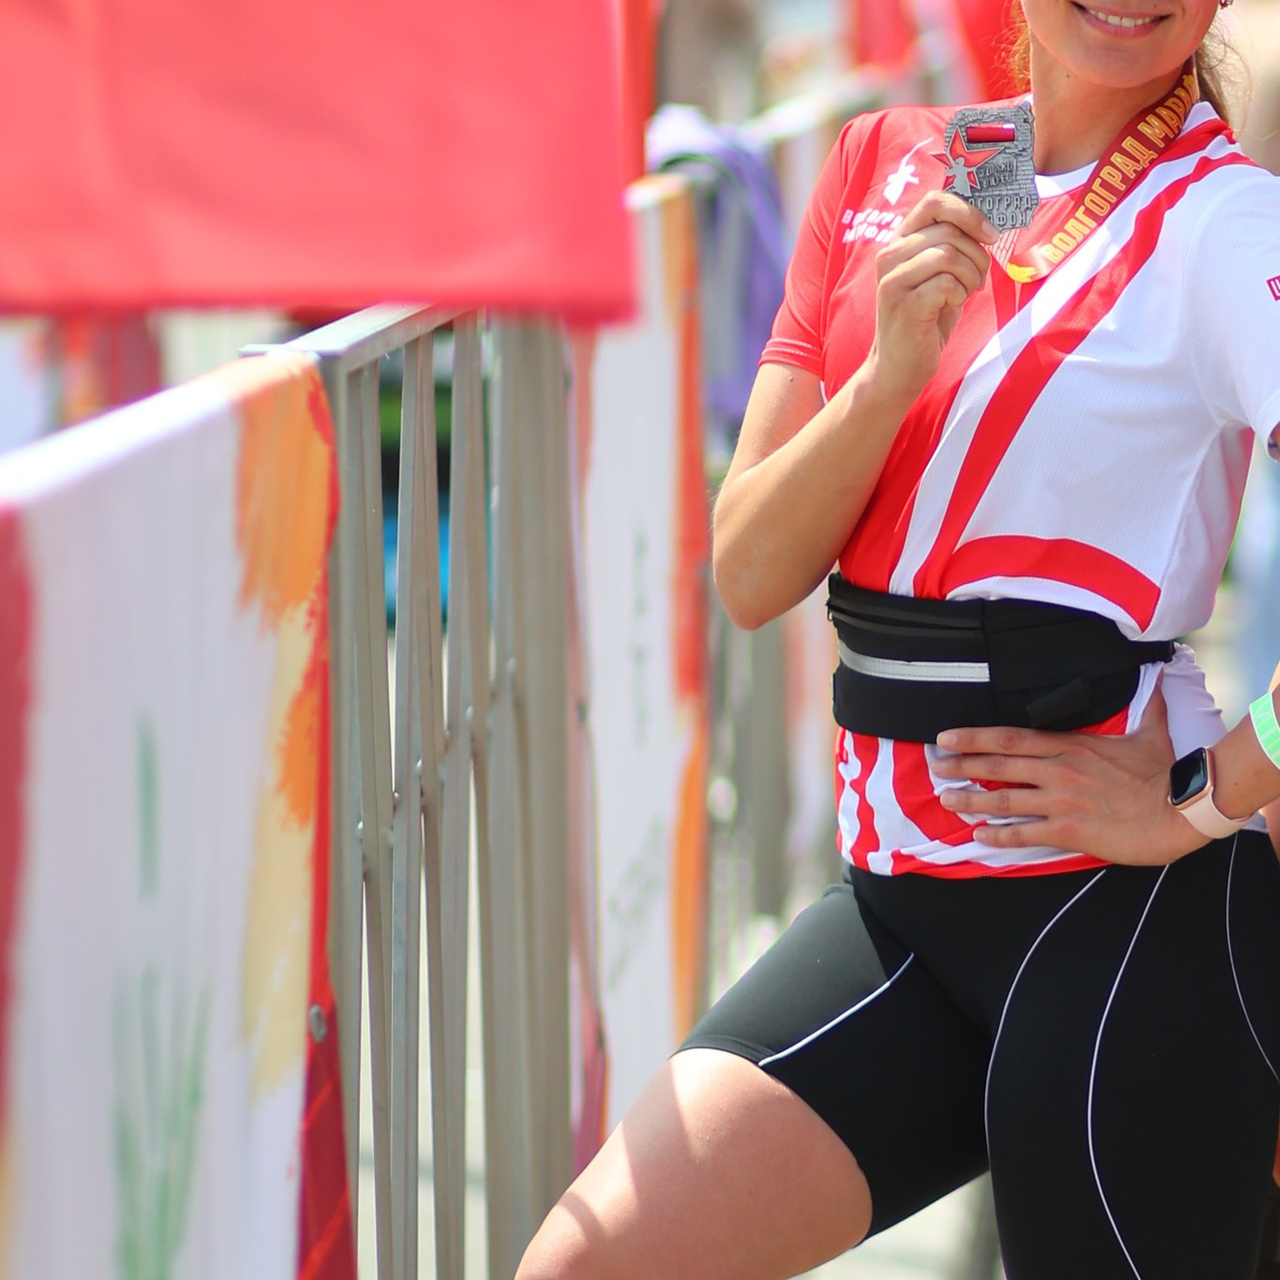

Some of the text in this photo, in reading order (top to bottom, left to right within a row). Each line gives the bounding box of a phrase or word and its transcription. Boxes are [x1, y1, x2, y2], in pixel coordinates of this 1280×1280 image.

[1039, 74, 1199, 265] ВОЛГОГРАД МАРАФ
[968, 195, 1031, 210] ГОГРАД
[987, 211, 1027, 226] АФОН
